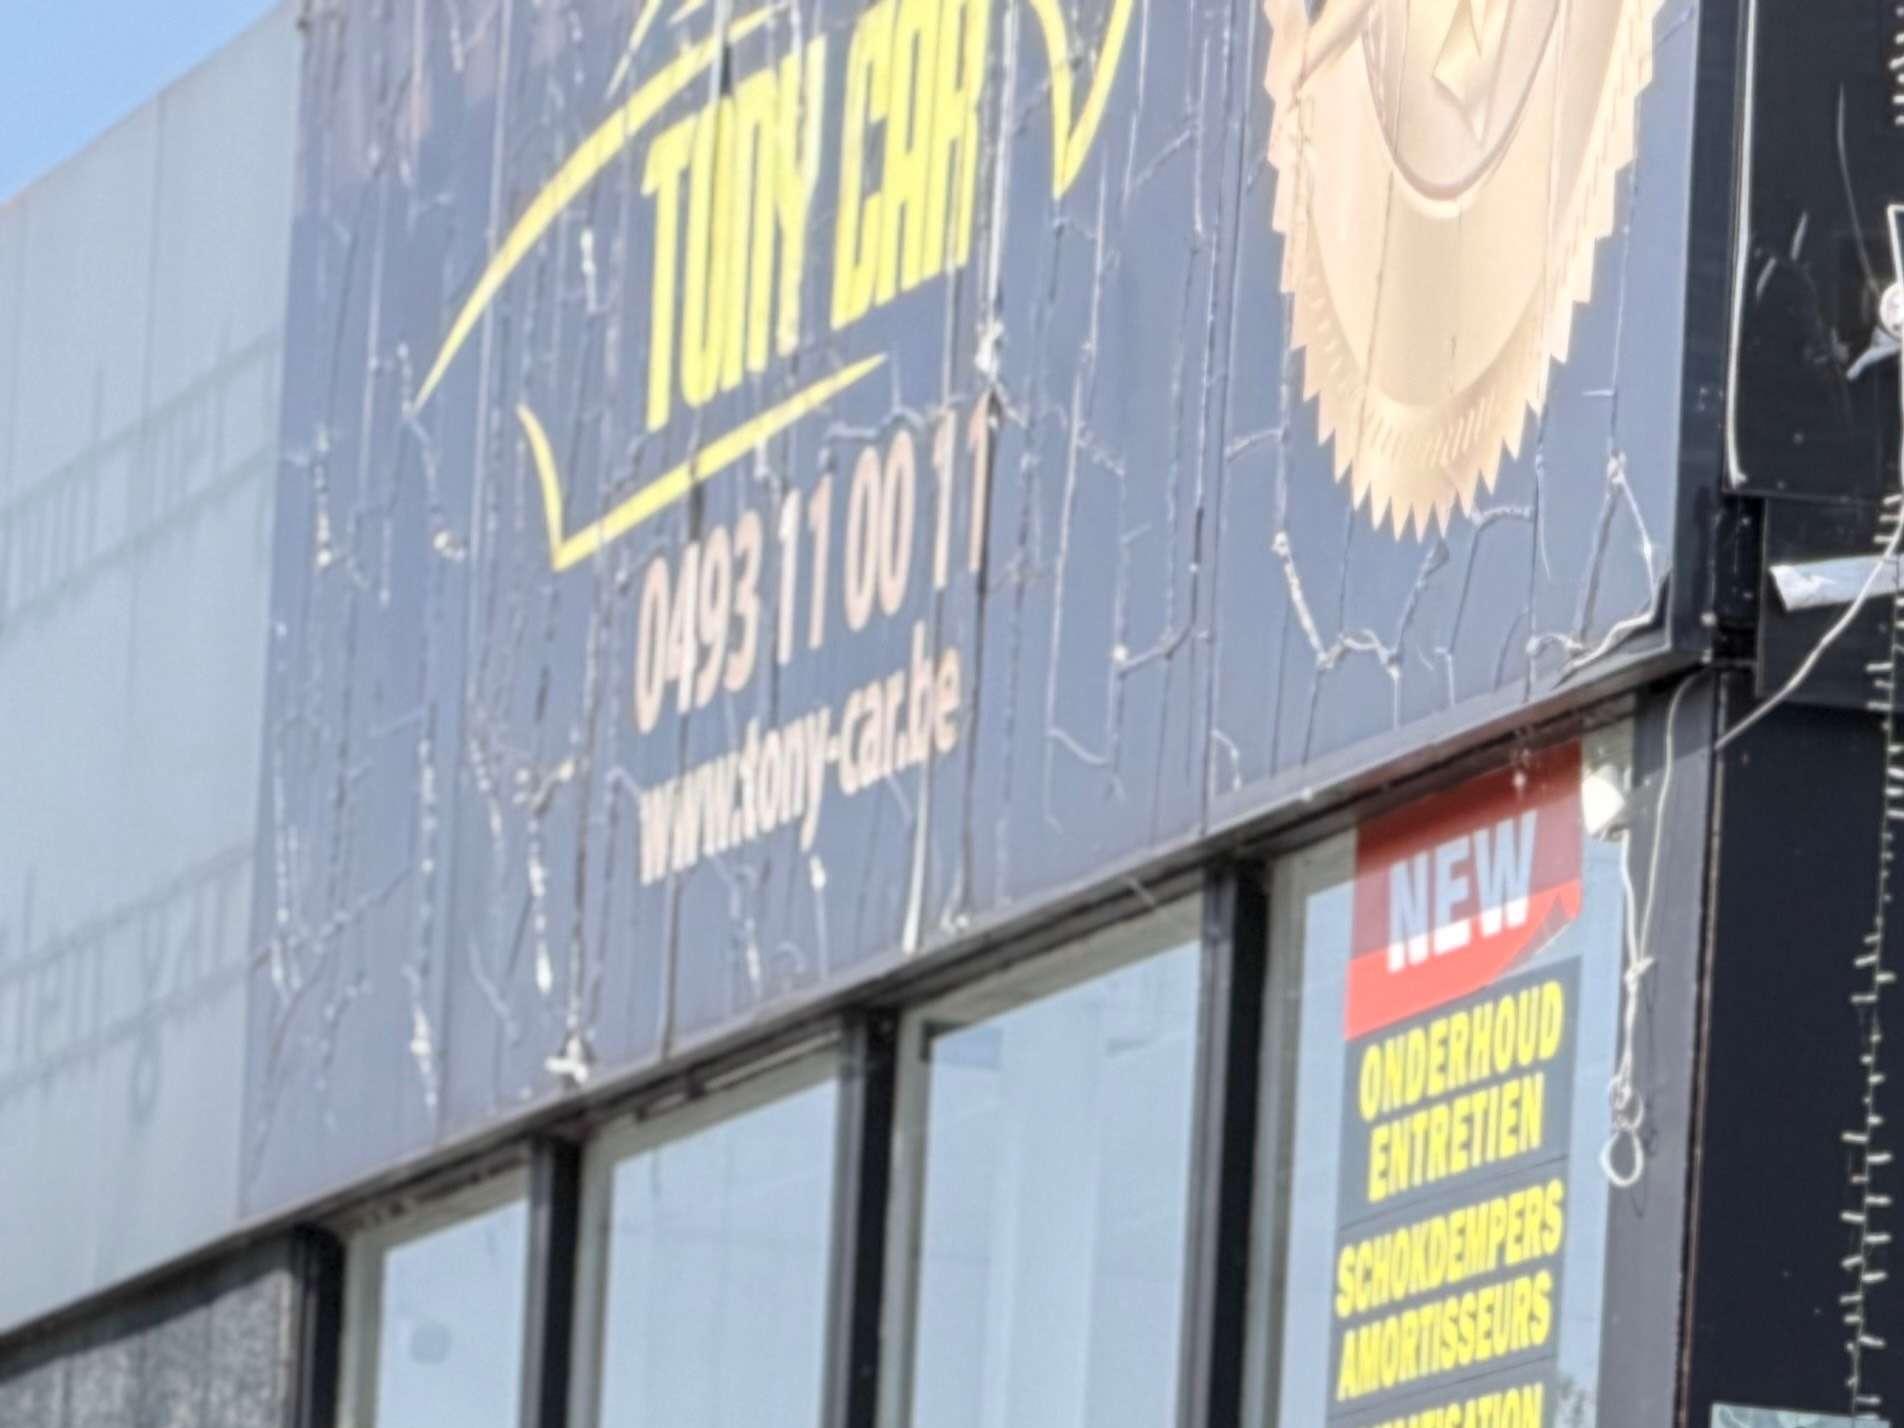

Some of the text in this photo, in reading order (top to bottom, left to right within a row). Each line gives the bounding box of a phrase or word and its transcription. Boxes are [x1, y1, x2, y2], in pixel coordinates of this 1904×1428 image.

[641, 0, 991, 433] TONY CAR
[634, 392, 993, 734] 0493 11 00 11
[639, 620, 962, 887] www.tony-car.be
[1387, 809, 1539, 973] NEW
[1360, 980, 1563, 1120] ONDERHOUD
[1368, 1072, 1543, 1202] ENTRETIEN
[1336, 1178, 1563, 1317] SCHOKDEMPERS
[1337, 1270, 1552, 1400] AMORTISSEURS
